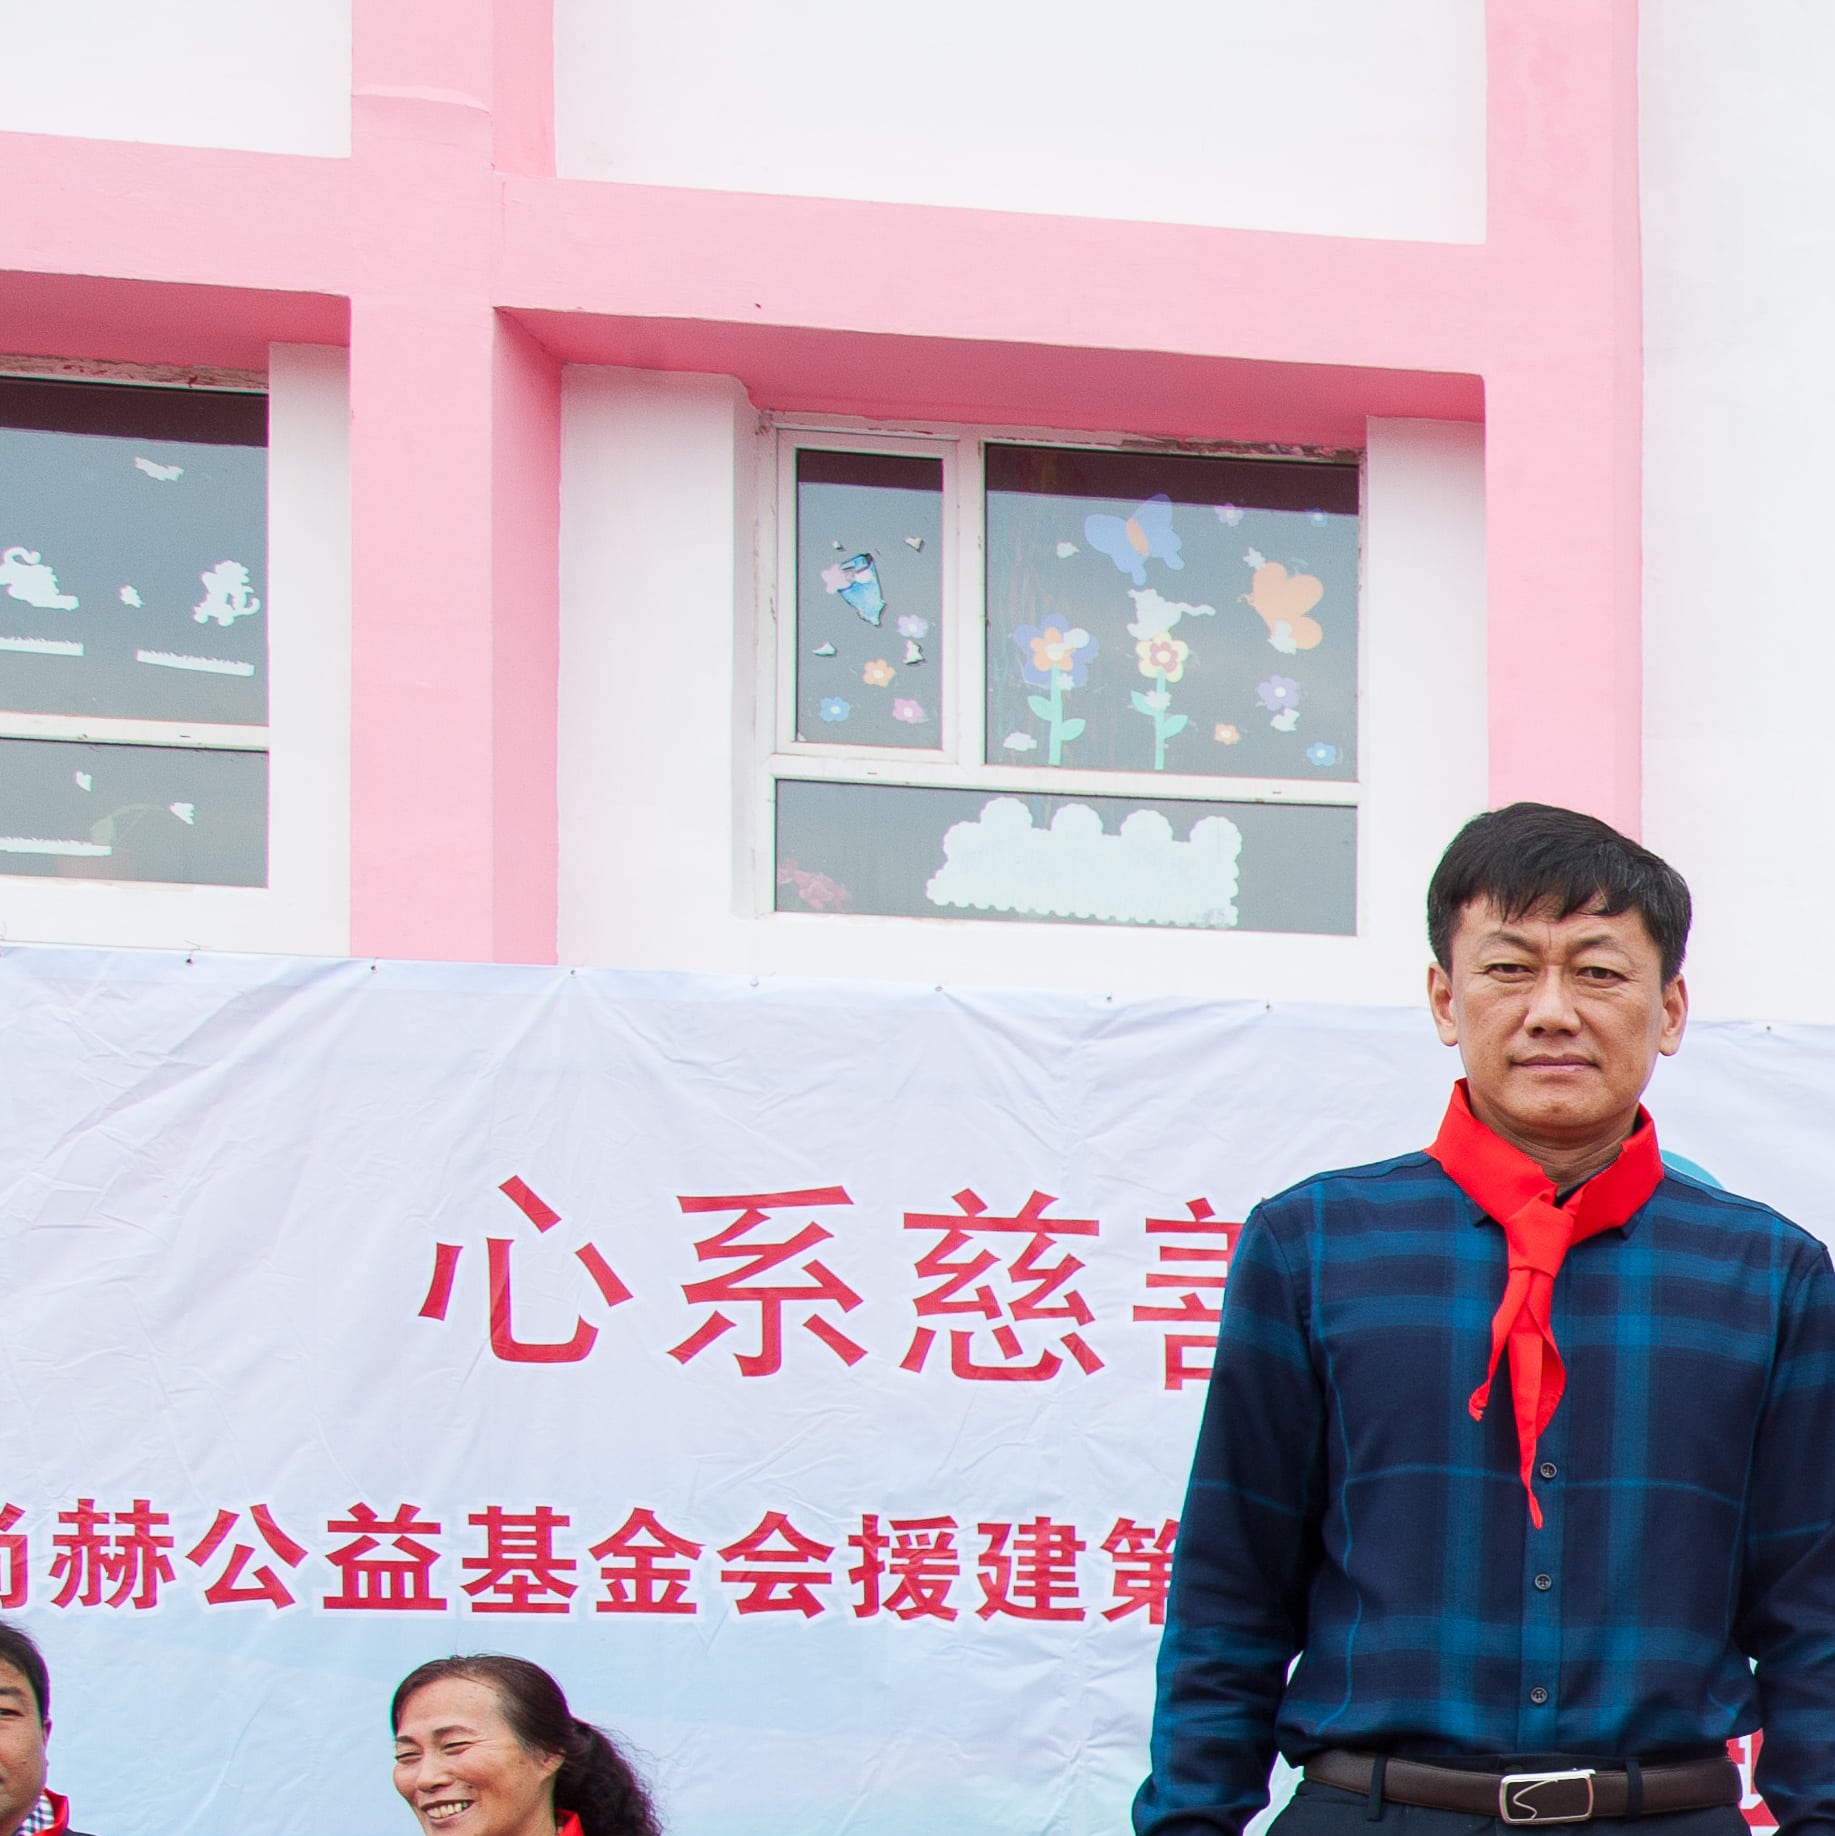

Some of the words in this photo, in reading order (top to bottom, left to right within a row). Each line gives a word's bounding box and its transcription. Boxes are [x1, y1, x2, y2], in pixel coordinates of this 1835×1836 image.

[0, 1497, 1180, 1625] 赫公益基金会援建第
